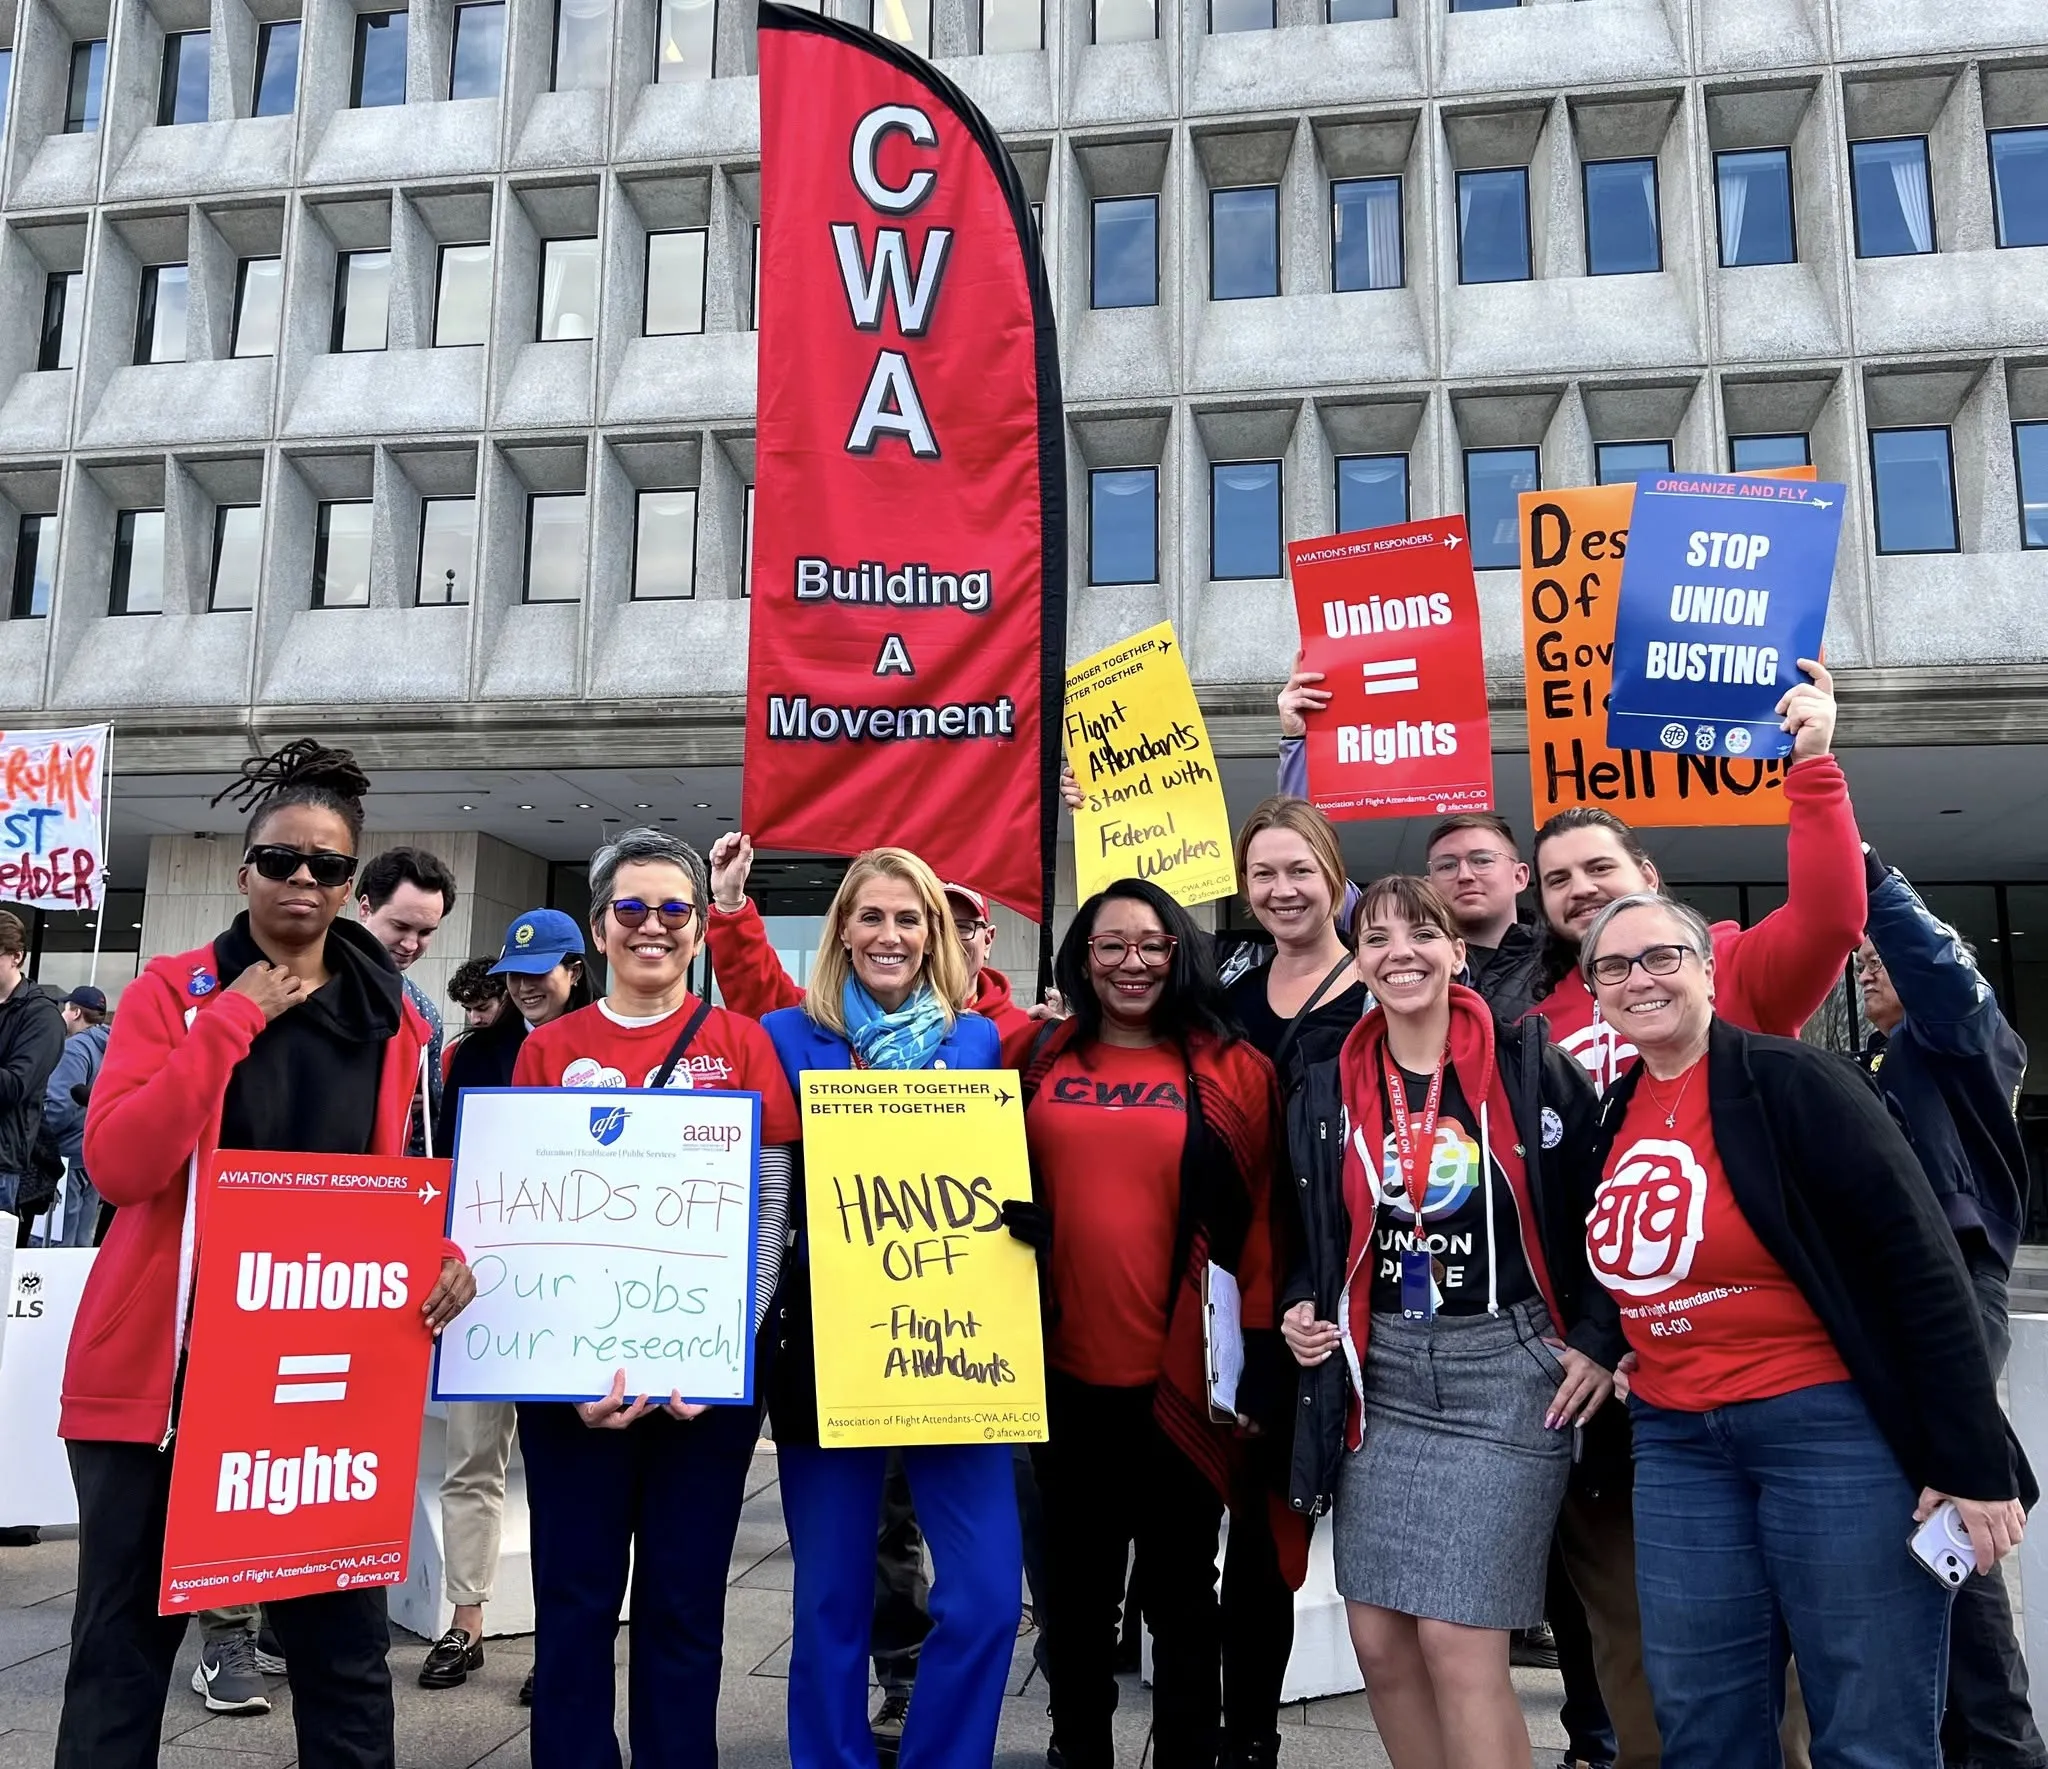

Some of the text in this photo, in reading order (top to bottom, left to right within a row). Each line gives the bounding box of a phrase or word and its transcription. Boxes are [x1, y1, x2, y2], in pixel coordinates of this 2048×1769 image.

[829, 102, 954, 459] CWA
[1655, 479, 1808, 500] ORGANIZE AND FLY
[1295, 533, 1434, 564] AVIATION'S FIRST RESPONDERS
[1686, 531, 1770, 571] STOP
[795, 556, 991, 613] Building
[1532, 572, 1601, 624] Of
[1670, 584, 1769, 627] UNION
[1322, 592, 1452, 639] Unions
[873, 632, 914, 678] A
[1065, 640, 1155, 689] RONGER TOGETHER
[1092, 662, 1144, 691] TOGETHER
[1646, 641, 1779, 687] BUSTING
[766, 694, 1016, 743] Movement
[1065, 700, 1127, 757] Flight
[1336, 720, 1458, 766] Rights
[0, 743, 95, 819] RUMP
[1088, 760, 1213, 812] stand with
[1544, 738, 1656, 804] Hell
[1315, 801, 1354, 810] Association
[1365, 797, 1384, 808] Flight
[1100, 811, 1175, 858] Federal
[1137, 838, 1221, 880] Workers
[809, 1083, 990, 1095] STRONGER TOGETHER
[810, 1103, 966, 1114] BETTER TOGETHER
[1054, 1076, 1186, 1111] CWA
[1388, 1074, 1410, 1154] NO MORE DELAY
[683, 1124, 741, 1152] aaup
[218, 1170, 409, 1189] AVIATION'S FIRST RESPONDERS
[465, 1169, 745, 1232] HANDS OFF
[833, 1173, 1003, 1246] HANDS
[235, 1251, 409, 1311] Unions
[883, 1235, 969, 1281] OFF
[7, 1299, 44, 1318] LS
[594, 1265, 709, 1330] jobs
[1650, 1317, 1693, 1337] AFL-CIO
[827, 1416, 881, 1428] Association
[883, 1415, 893, 1426] of
[895, 1414, 920, 1428] Flight
[996, 1427, 1043, 1440] afacwa.org
[215, 1446, 379, 1516] Rights
[169, 1576, 229, 1591] Association
[232, 1572, 244, 1583] of
[246, 1567, 274, 1584] Flight
[350, 1570, 400, 1584] afacwa.org
